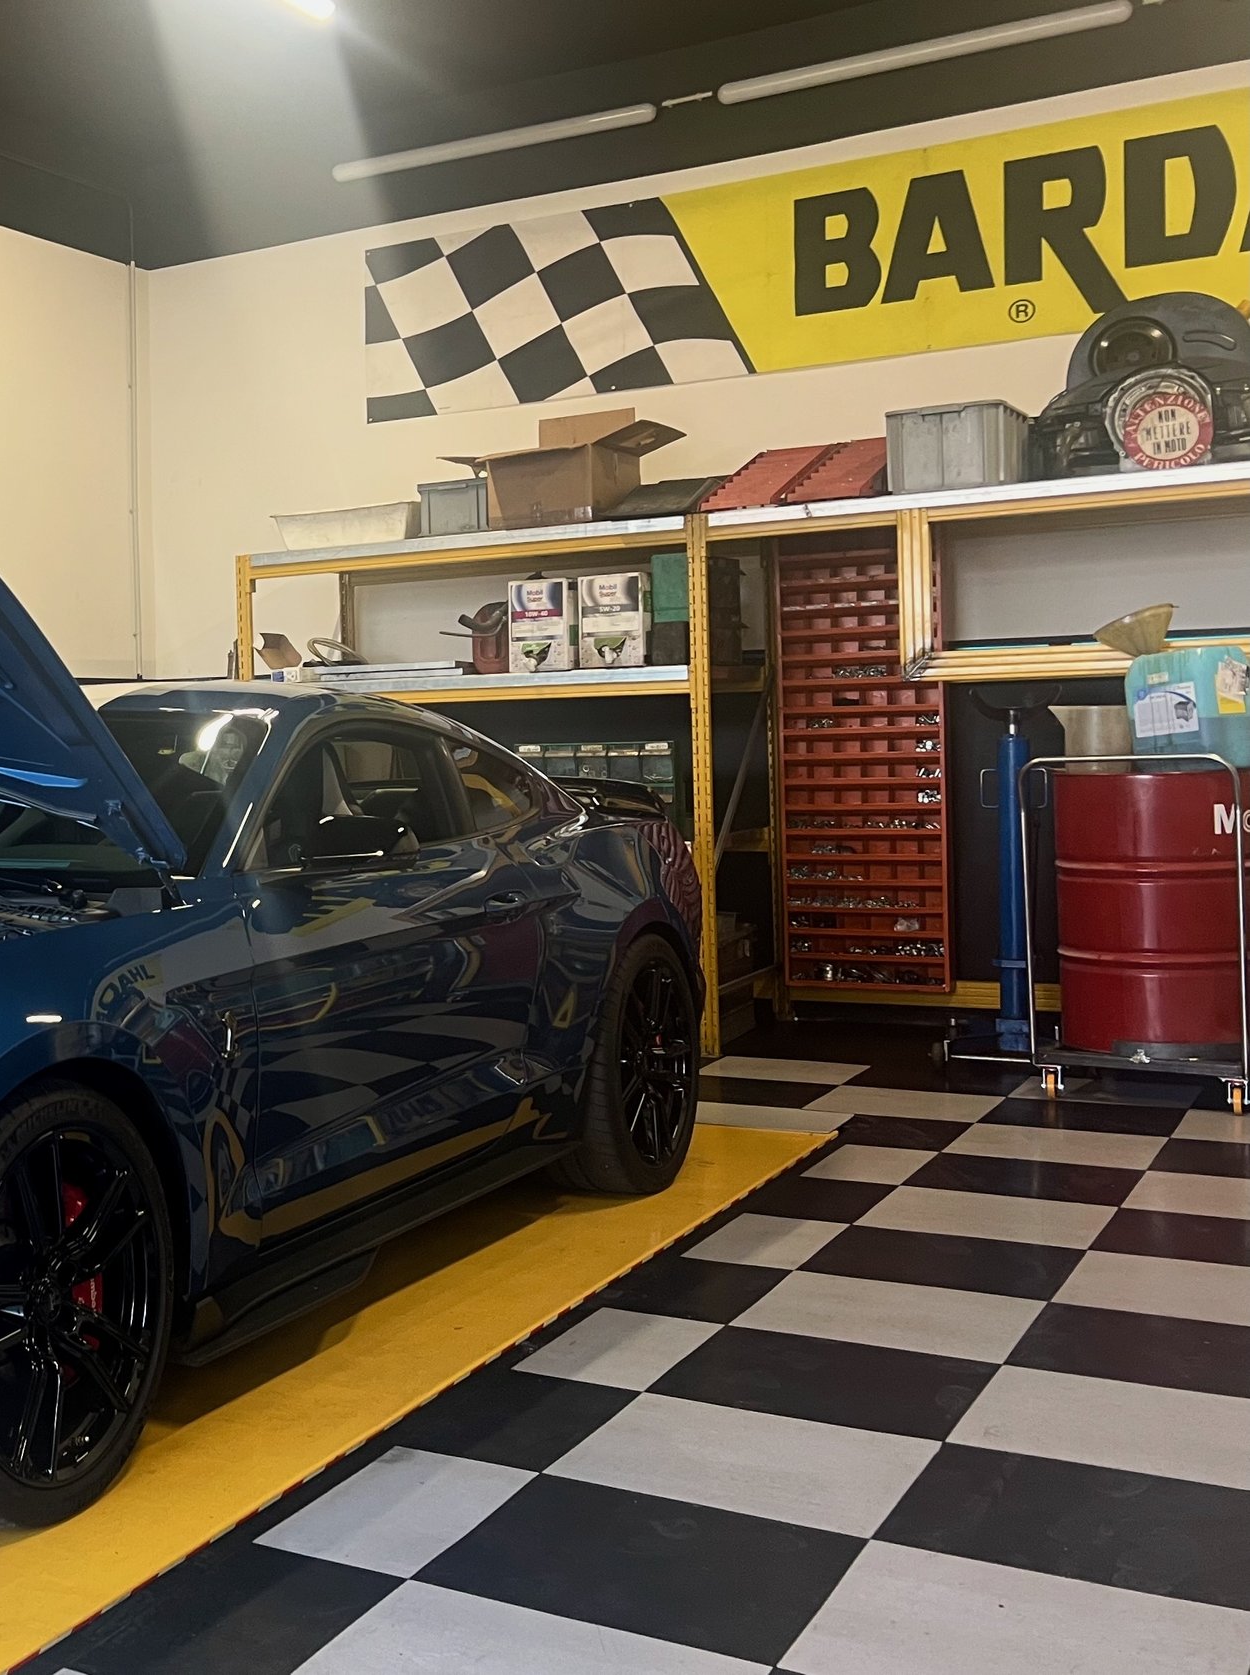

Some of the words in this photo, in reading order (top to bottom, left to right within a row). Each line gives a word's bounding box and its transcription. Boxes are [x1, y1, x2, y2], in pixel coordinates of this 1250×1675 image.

[793, 124, 1250, 316] BARD
[1157, 408, 1177, 424] NON
[1145, 421, 1191, 441] METTERE
[1152, 440, 1162, 455] IN
[1164, 438, 1187, 454] MOTO
[1134, 443, 1206, 470] PERICOLO
[526, 589, 544, 597] Mobil
[598, 583, 618, 591] Mobil
